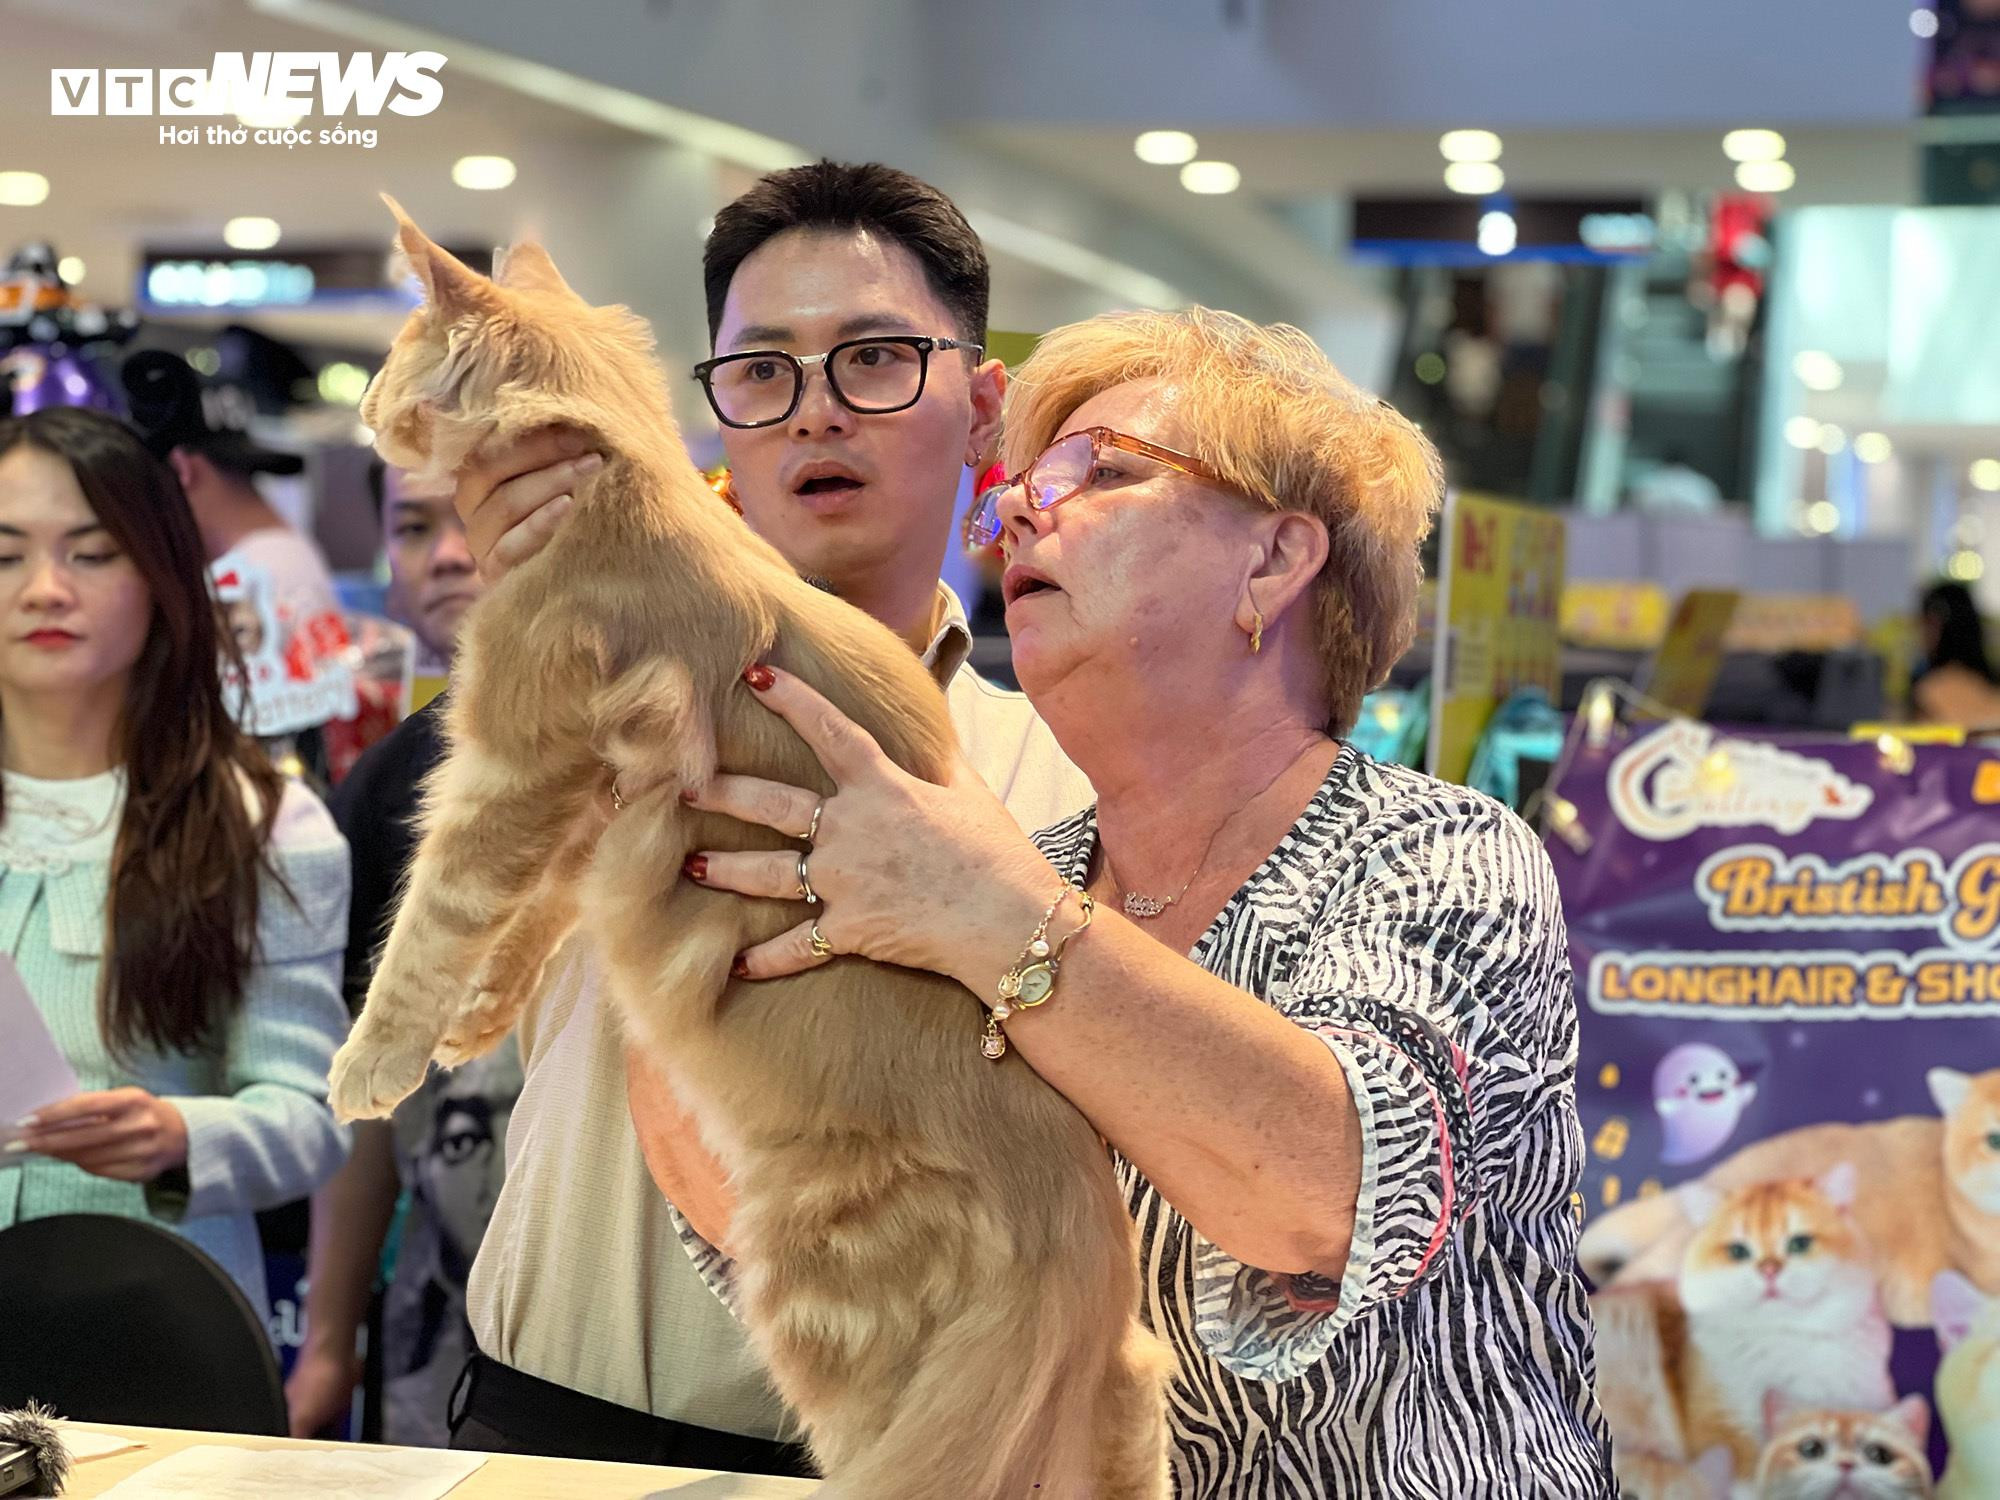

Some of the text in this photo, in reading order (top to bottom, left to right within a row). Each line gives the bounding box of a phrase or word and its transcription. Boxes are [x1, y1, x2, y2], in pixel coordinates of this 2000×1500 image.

[1708, 855, 1948, 919] Bristish
[1601, 961, 1858, 1006] LONGHAIR
[1864, 962, 1909, 1006] &
